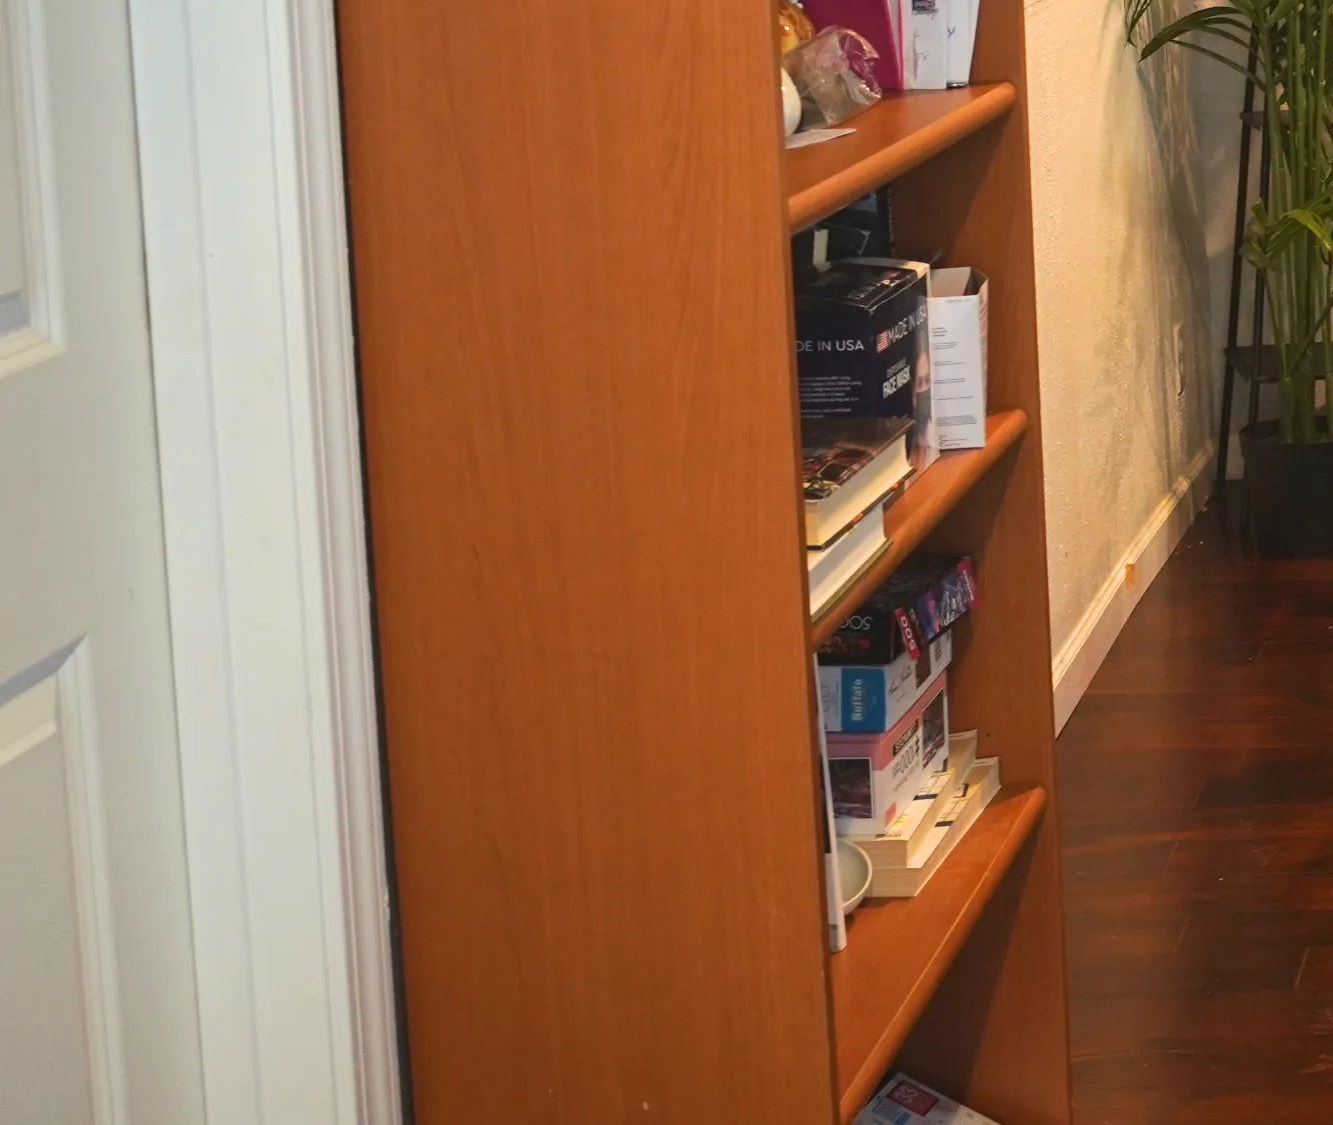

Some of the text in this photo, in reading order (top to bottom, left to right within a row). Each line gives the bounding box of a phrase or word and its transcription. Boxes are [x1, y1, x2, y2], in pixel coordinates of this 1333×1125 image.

[796, 339, 865, 352] DE IN USA
[850, 677, 864, 723] Buffalo
